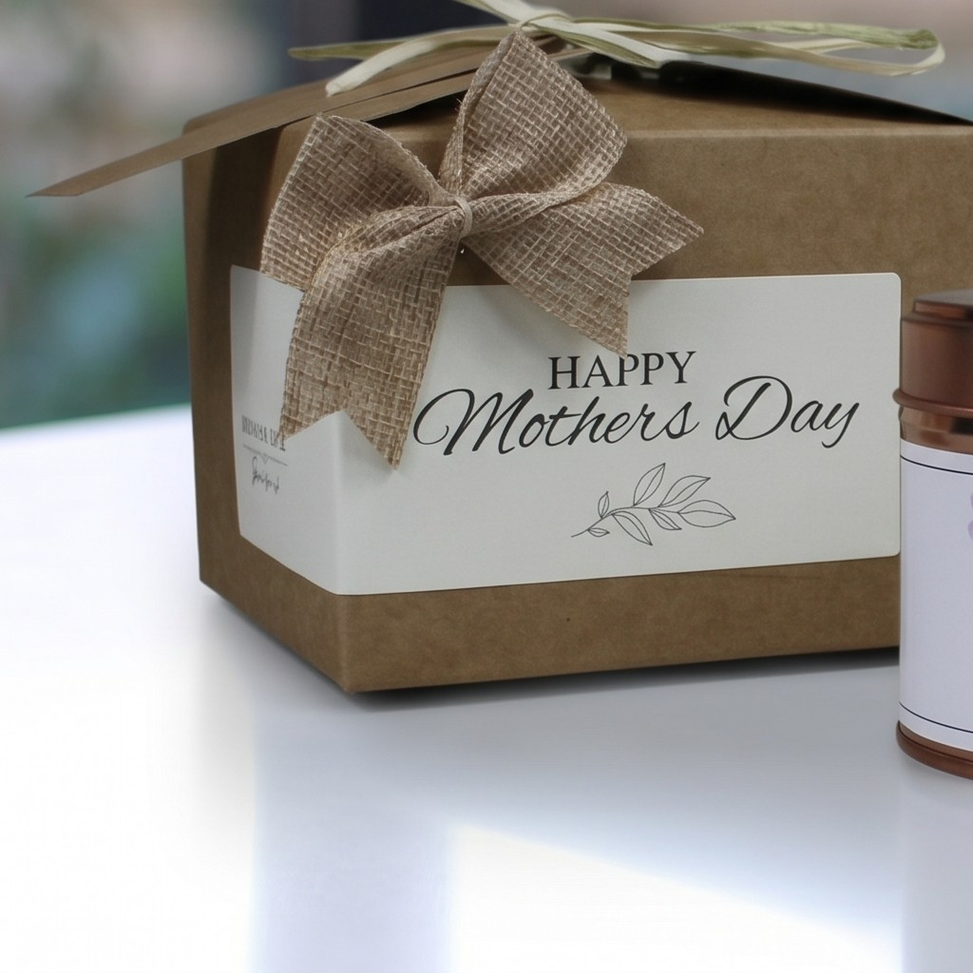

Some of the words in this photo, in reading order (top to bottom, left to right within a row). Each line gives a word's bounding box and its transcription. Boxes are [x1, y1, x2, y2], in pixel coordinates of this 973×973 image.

[548, 351, 696, 390] HAPPY
[413, 389, 700, 456] Mothers
[715, 376, 860, 449] Day
